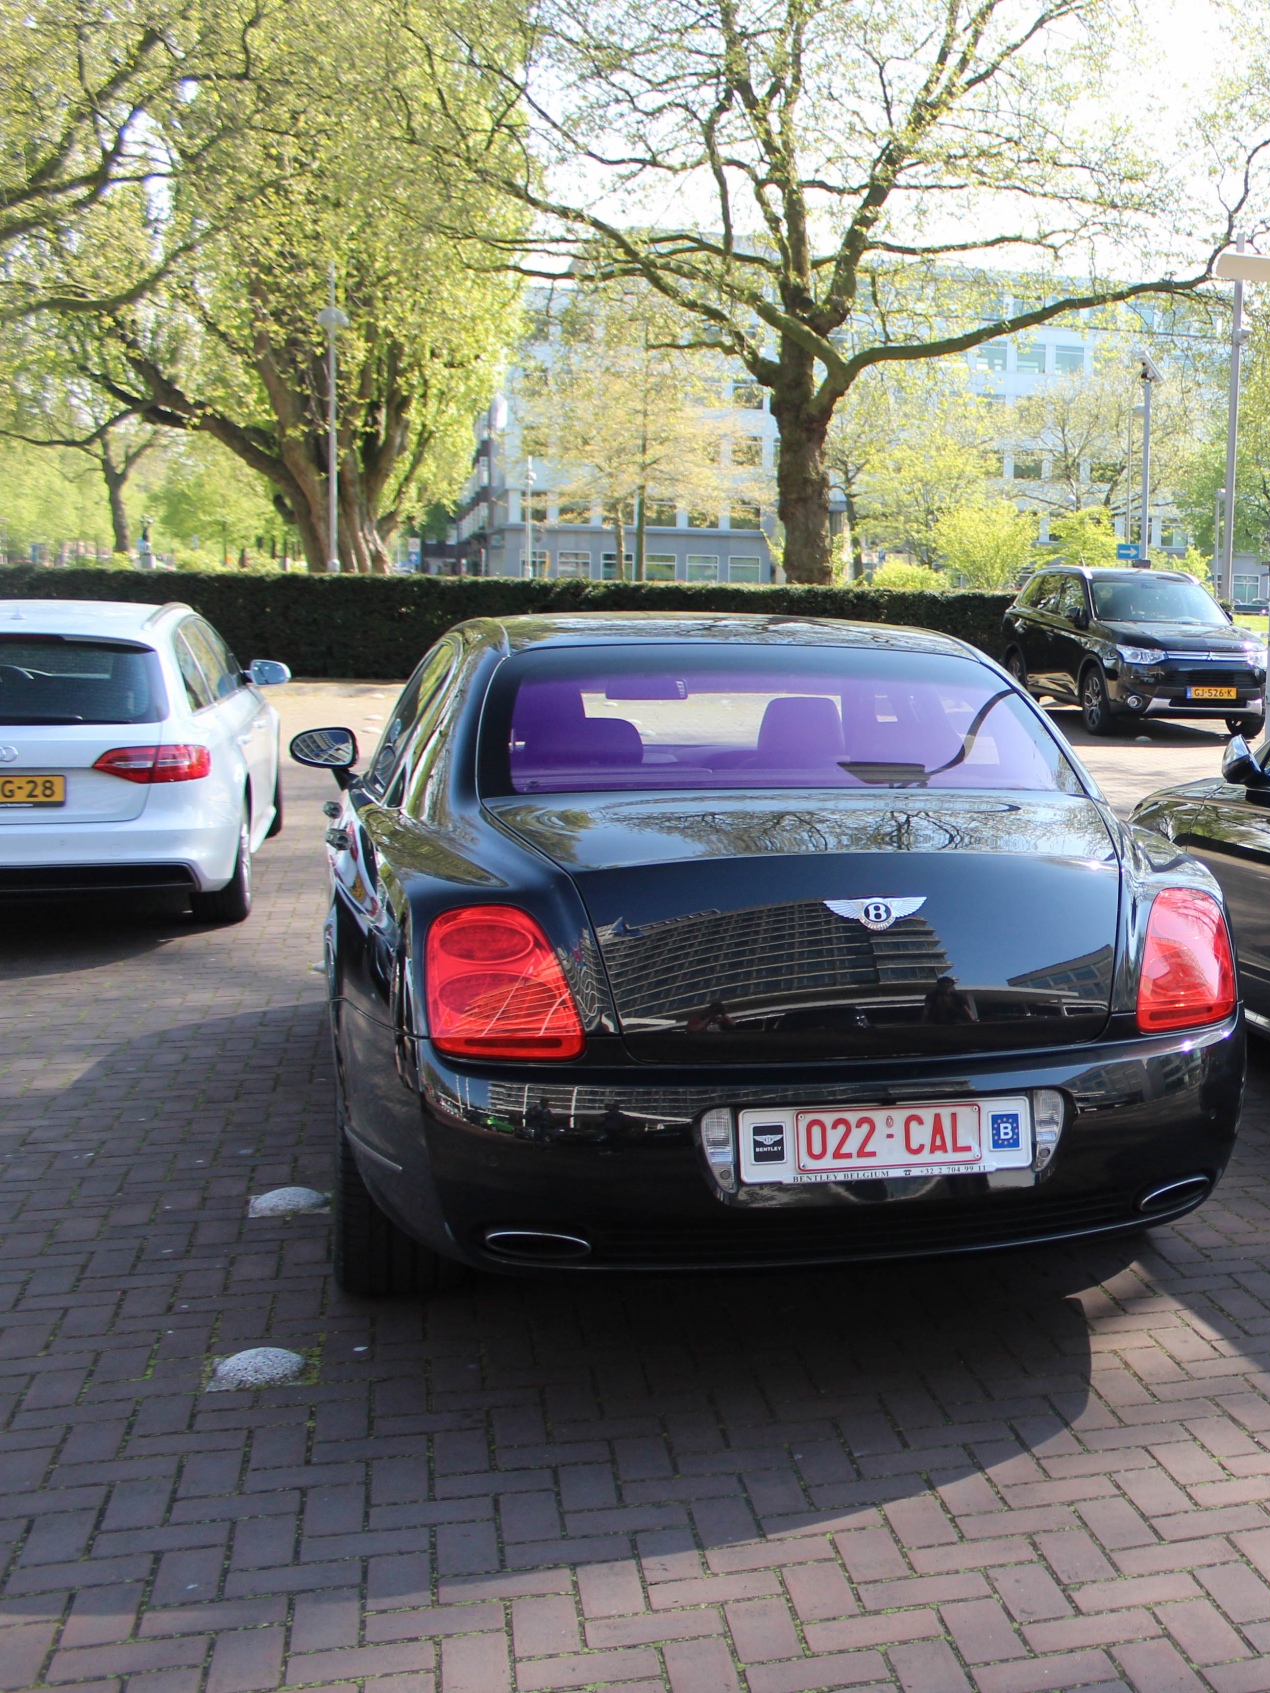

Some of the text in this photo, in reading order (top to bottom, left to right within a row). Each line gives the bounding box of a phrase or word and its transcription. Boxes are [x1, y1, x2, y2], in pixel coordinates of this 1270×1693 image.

[1194, 688, 1233, 697] GJ-526-K
[999, 1123, 1013, 1139] B
[793, 1173, 839, 1183] BENTLEY
[843, 1170, 889, 1180] BELGIUM
